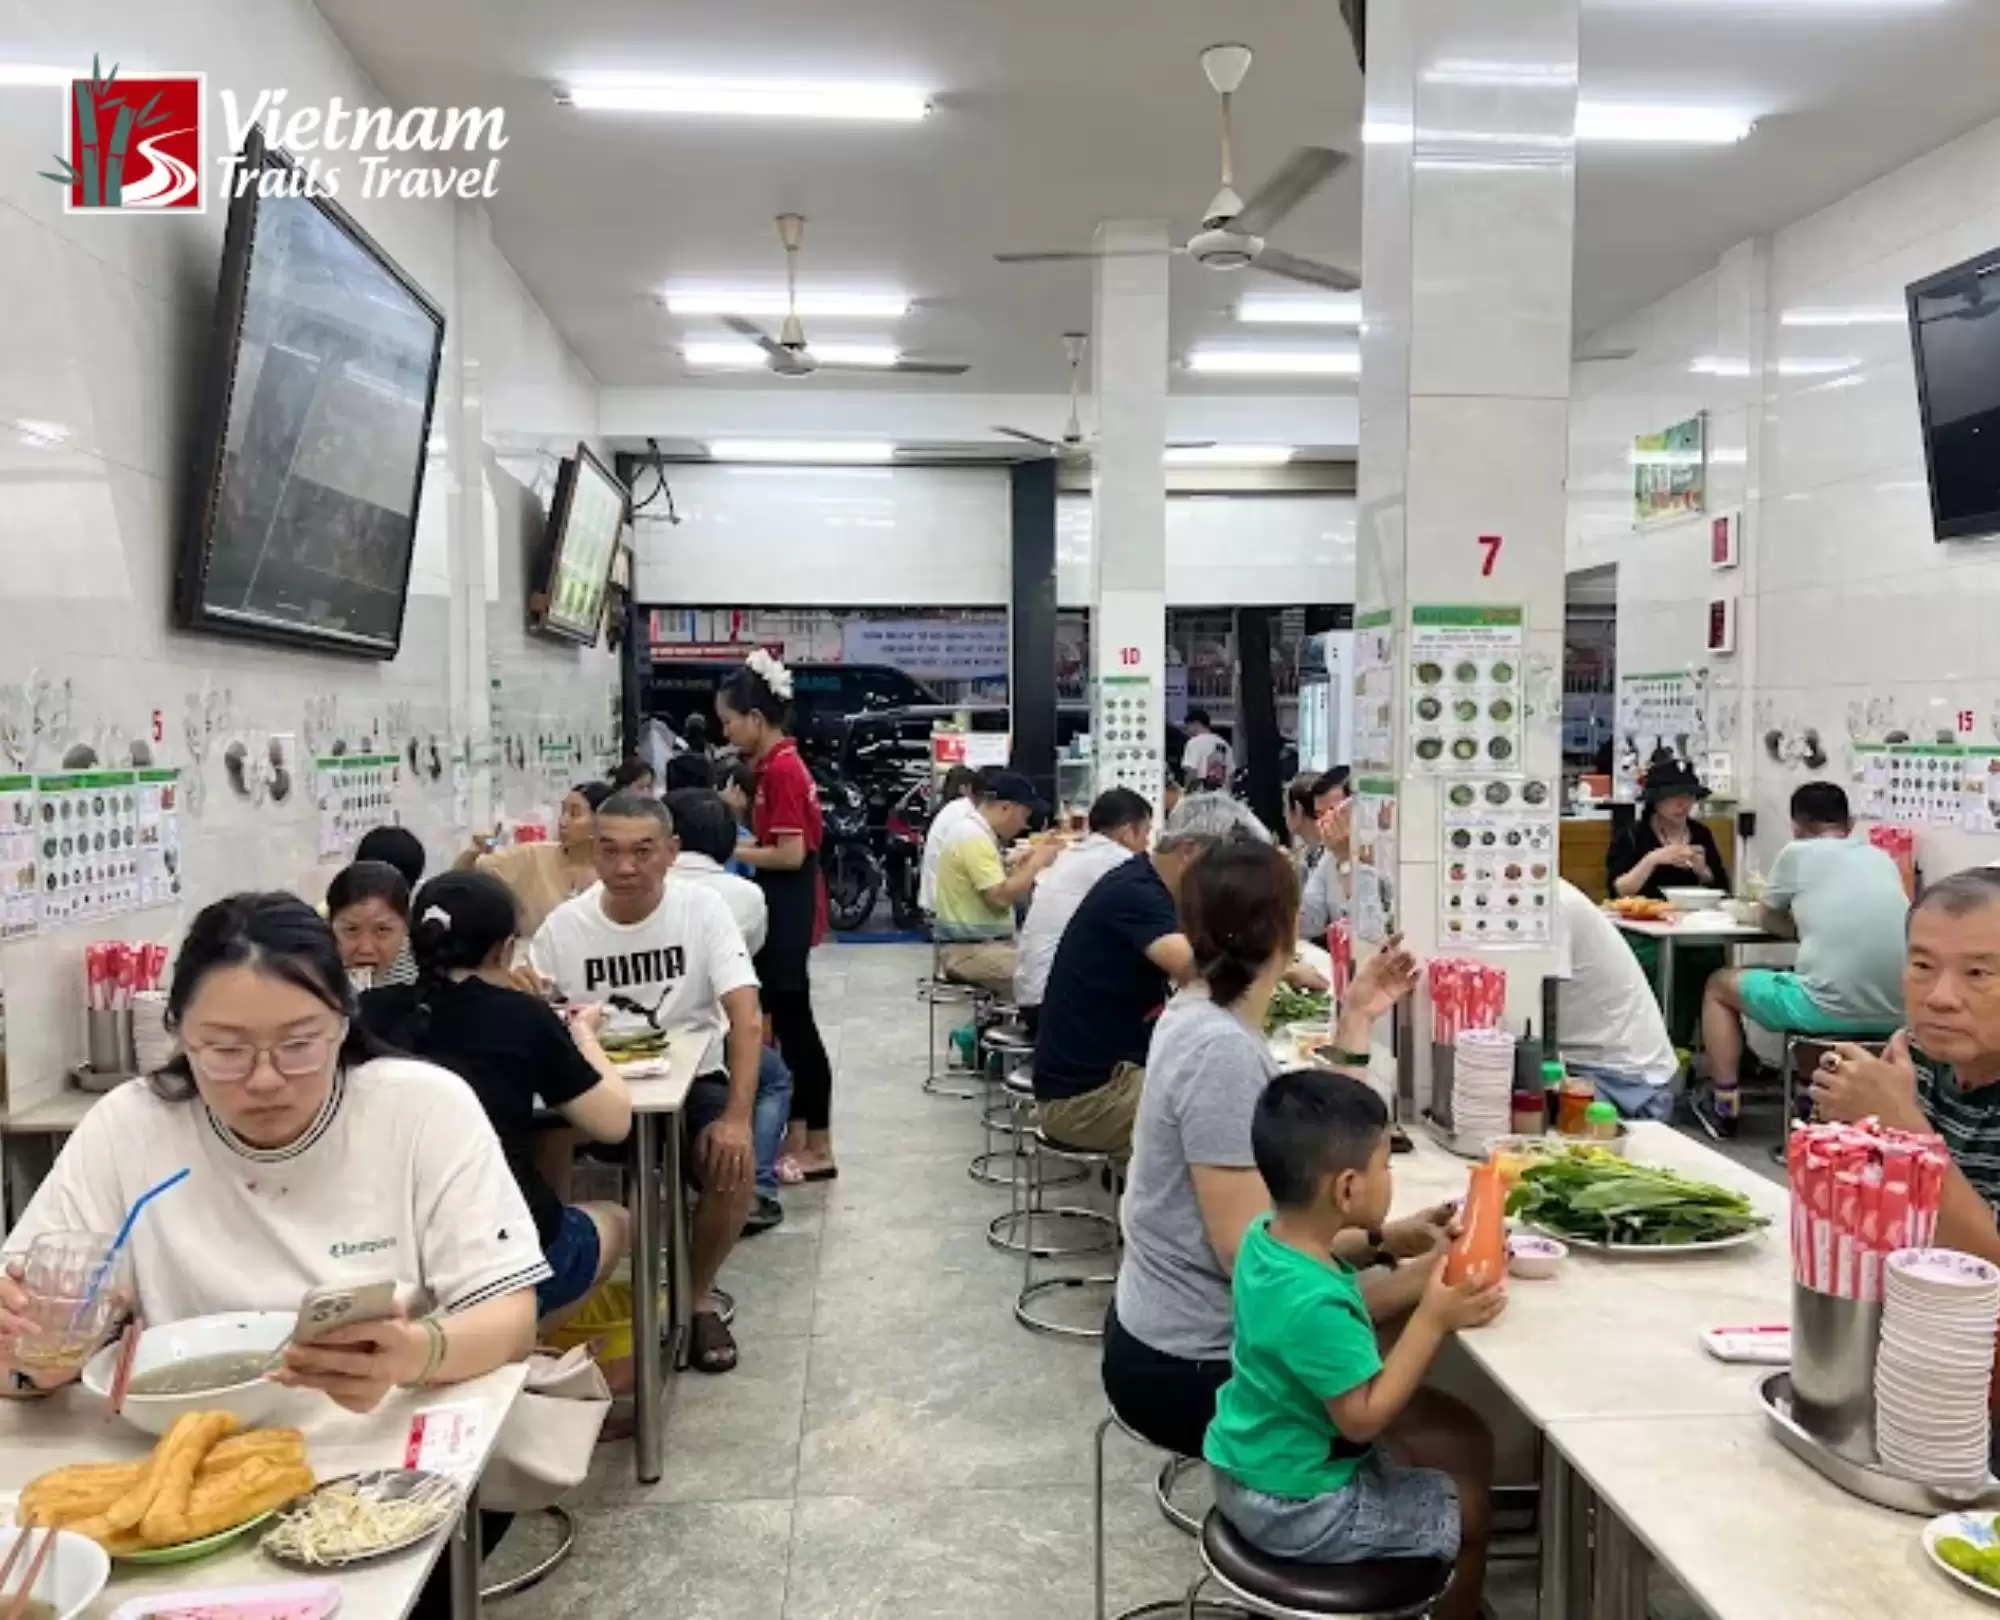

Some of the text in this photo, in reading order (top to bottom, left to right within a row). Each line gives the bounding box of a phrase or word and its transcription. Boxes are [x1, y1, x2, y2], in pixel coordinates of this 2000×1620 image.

[1478, 535, 1503, 577] 7
[1119, 647, 1142, 666] 10
[151, 709, 163, 743] 5
[1957, 710, 1974, 733] 15
[584, 945, 686, 992] PUMA
